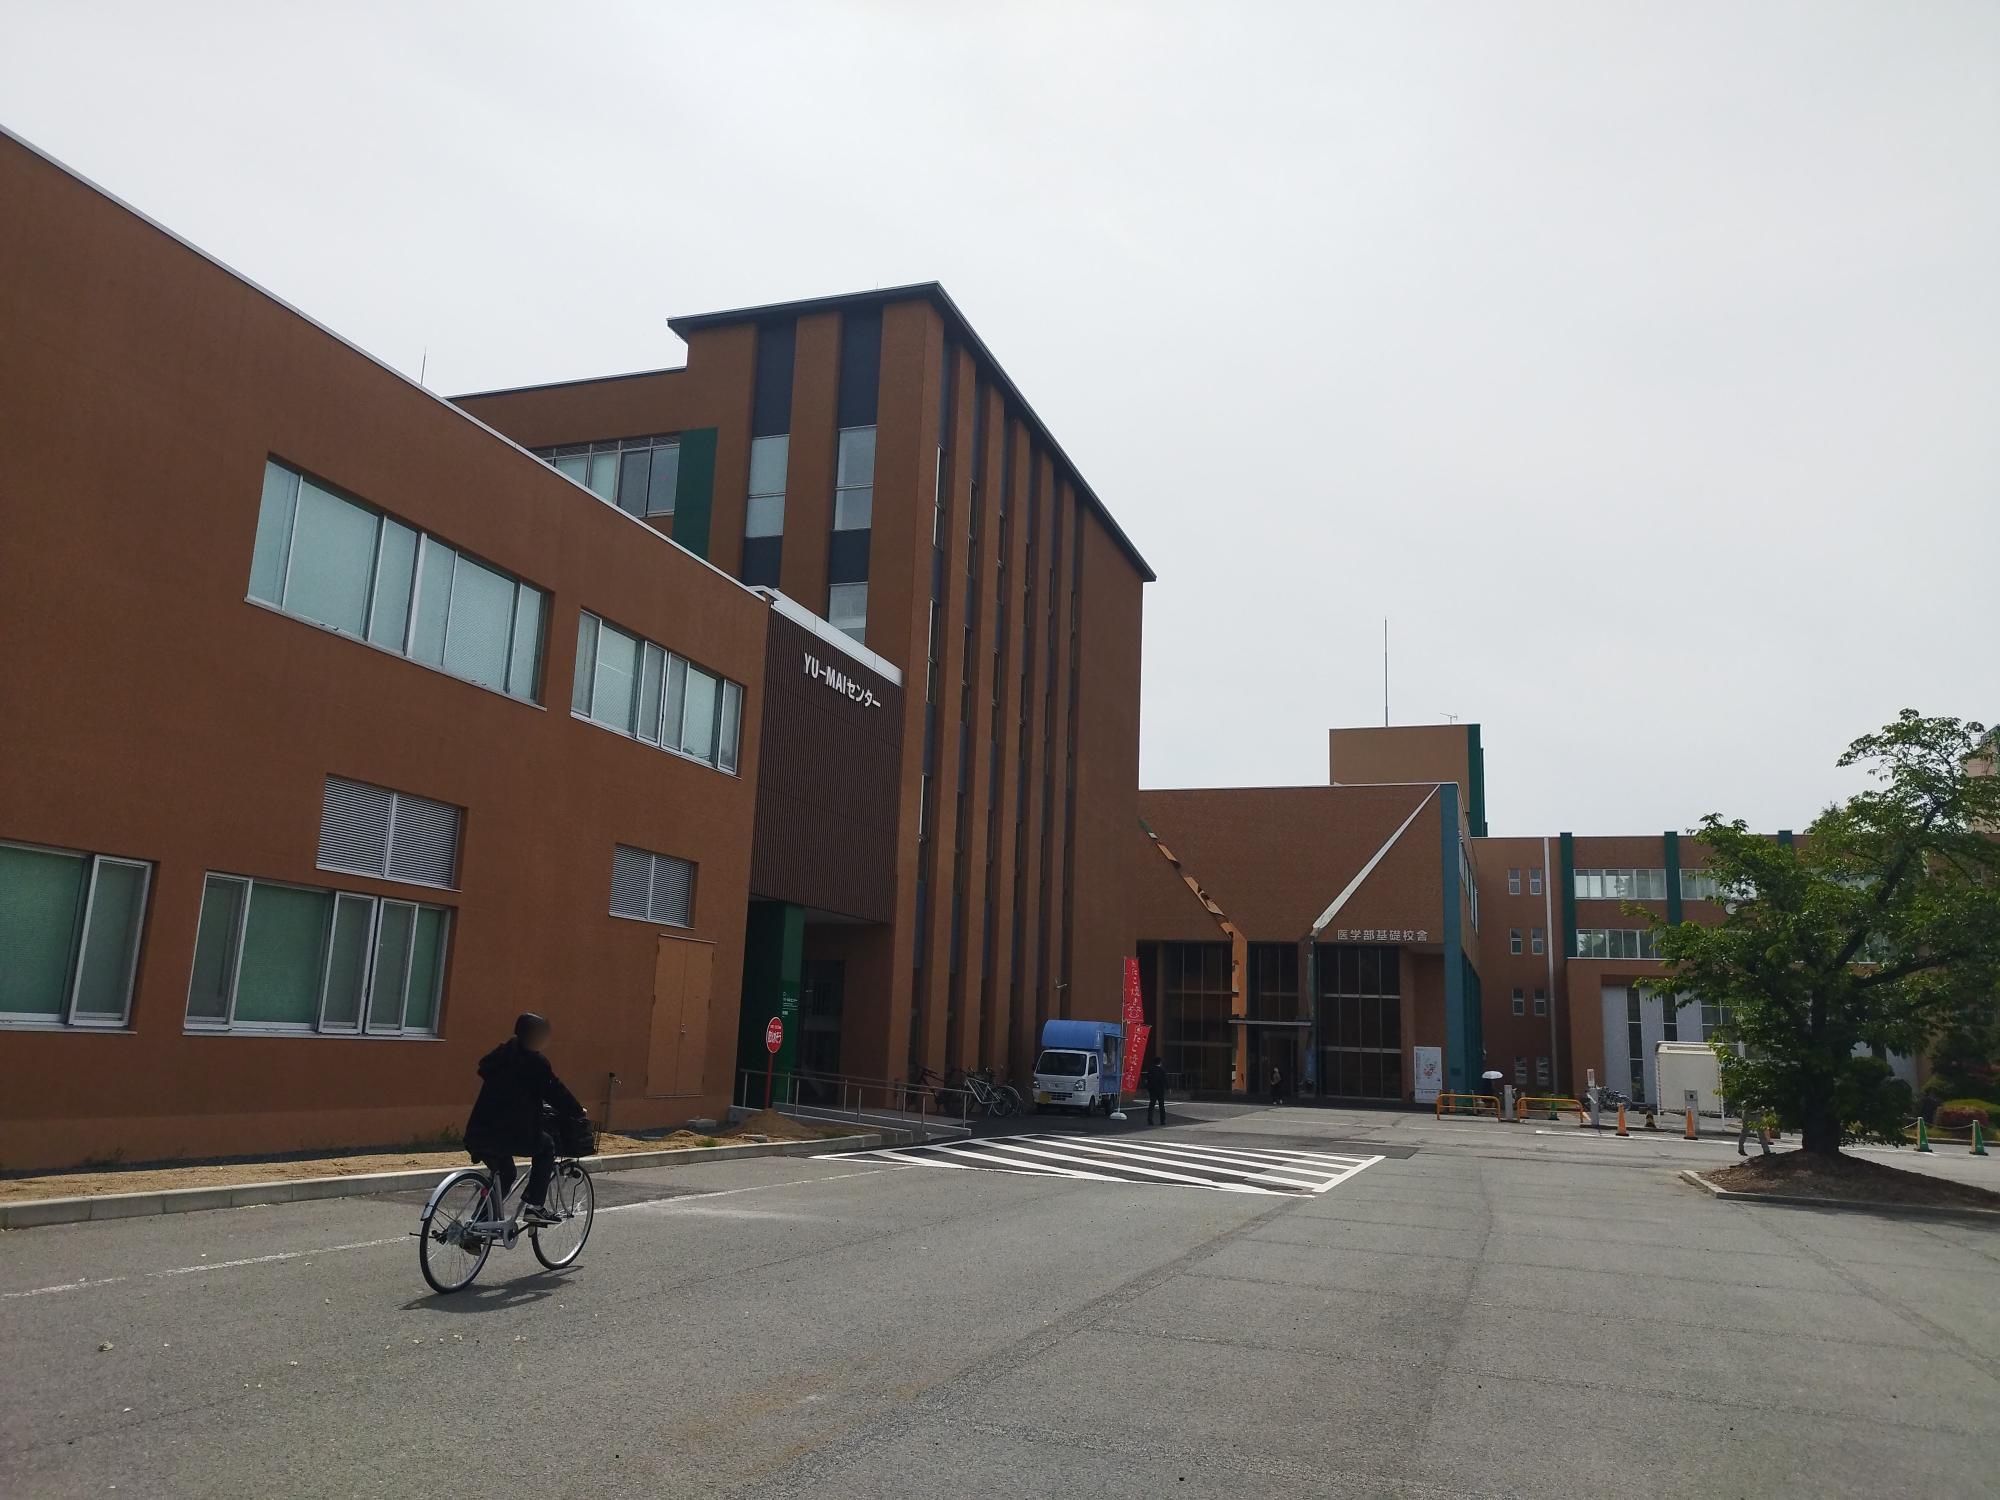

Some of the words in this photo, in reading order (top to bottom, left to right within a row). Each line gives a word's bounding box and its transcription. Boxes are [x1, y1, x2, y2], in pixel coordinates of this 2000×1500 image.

[804, 653, 881, 708] YU-MAIセンター
[1337, 929, 1428, 942] 医学部基礎校舎
